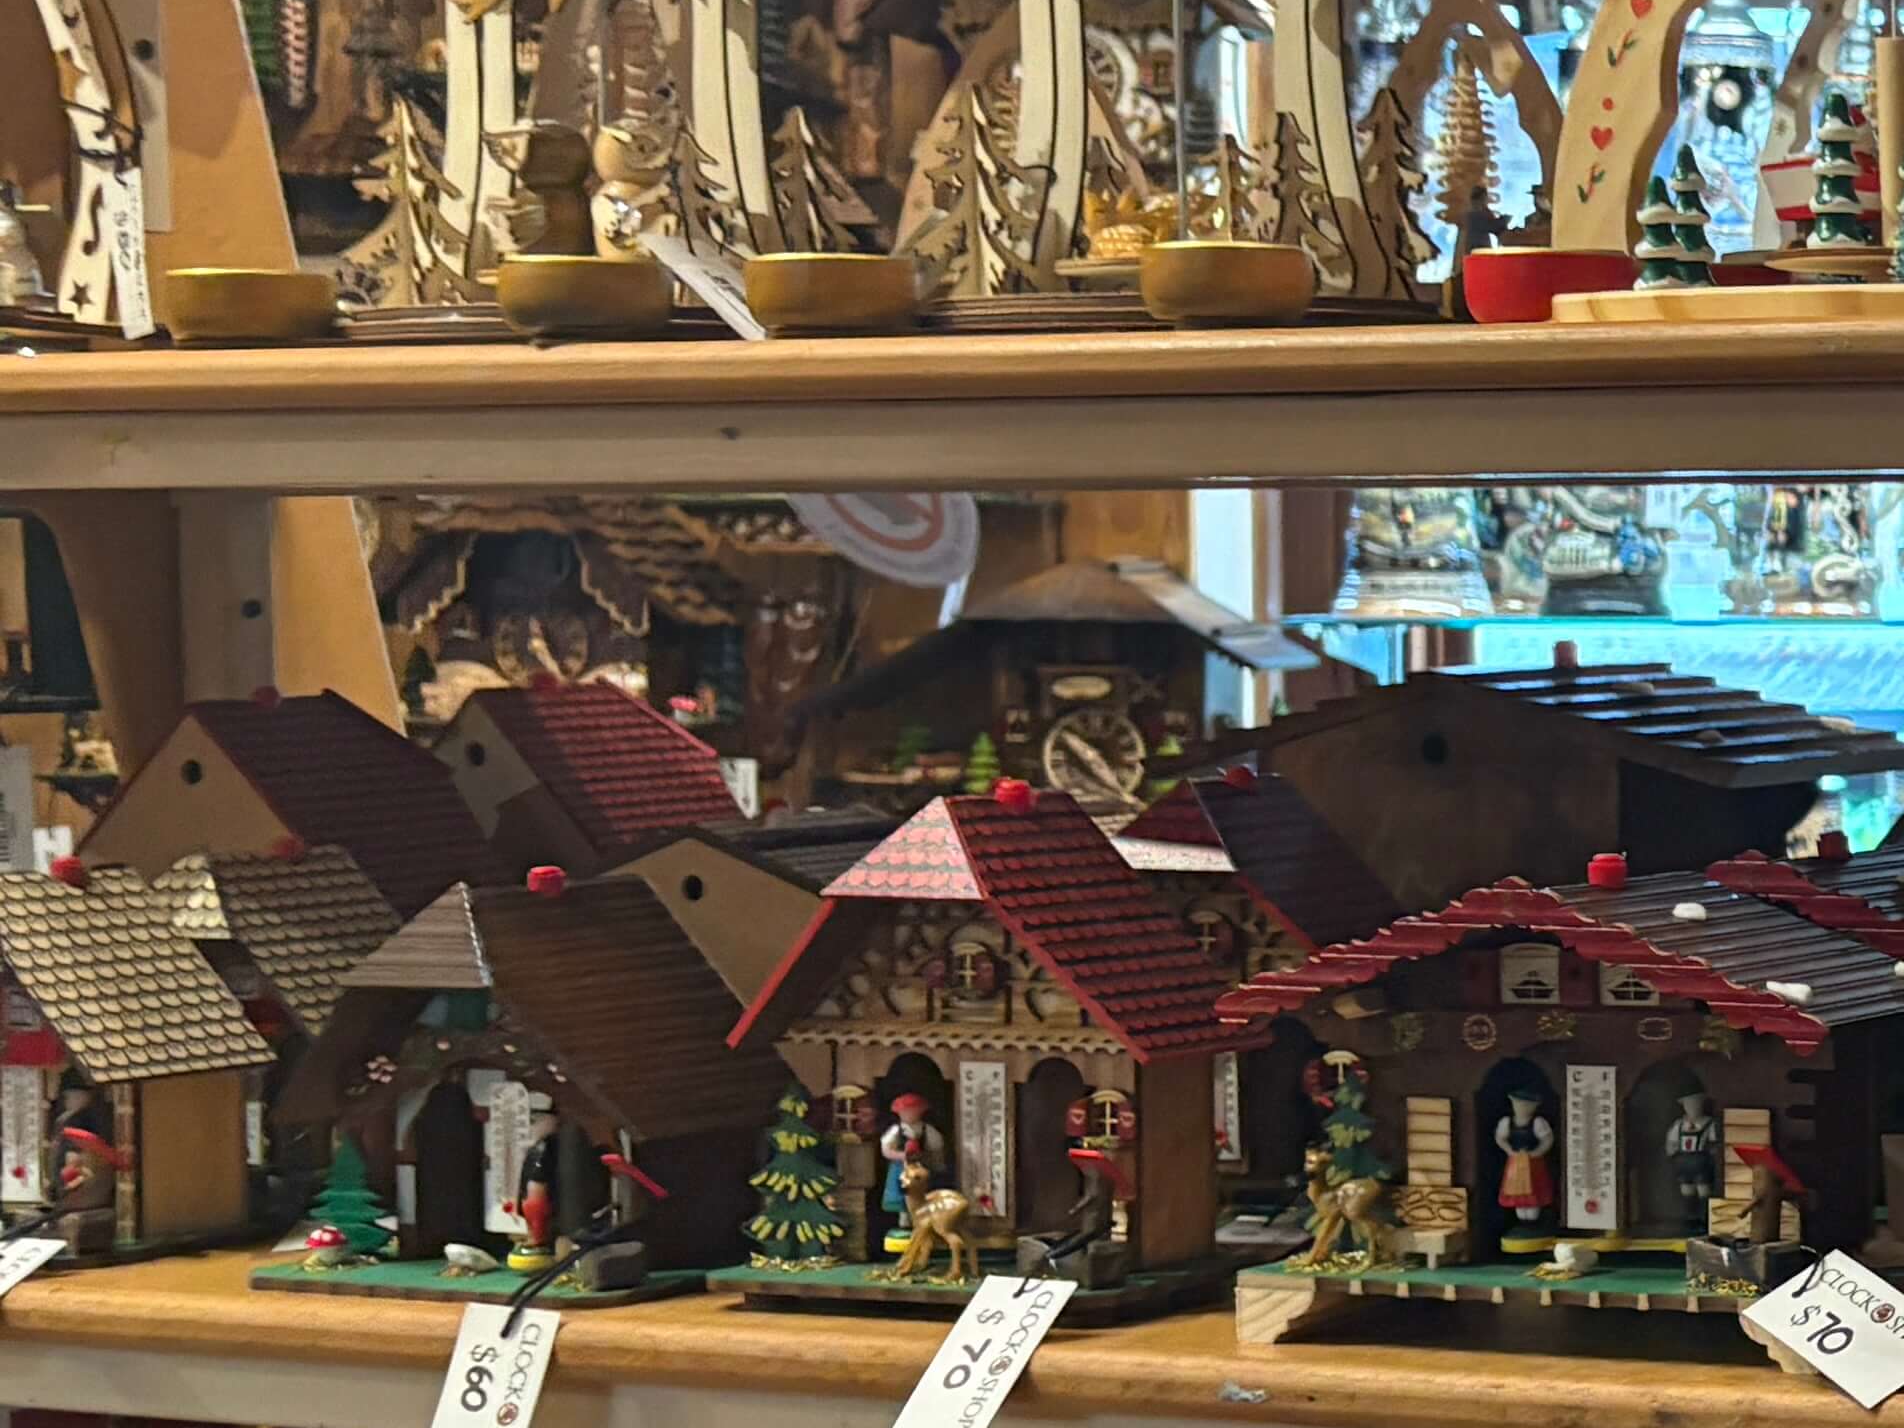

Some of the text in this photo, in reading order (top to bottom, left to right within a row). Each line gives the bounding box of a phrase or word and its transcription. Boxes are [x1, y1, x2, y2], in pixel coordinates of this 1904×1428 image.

[1000, 1290, 1055, 1355] CLOCK
[1819, 1267, 1881, 1313] CLOCK
[503, 1323, 542, 1400] CLOCK
[1790, 1304, 1854, 1356] $70
[460, 1343, 498, 1413] $60
